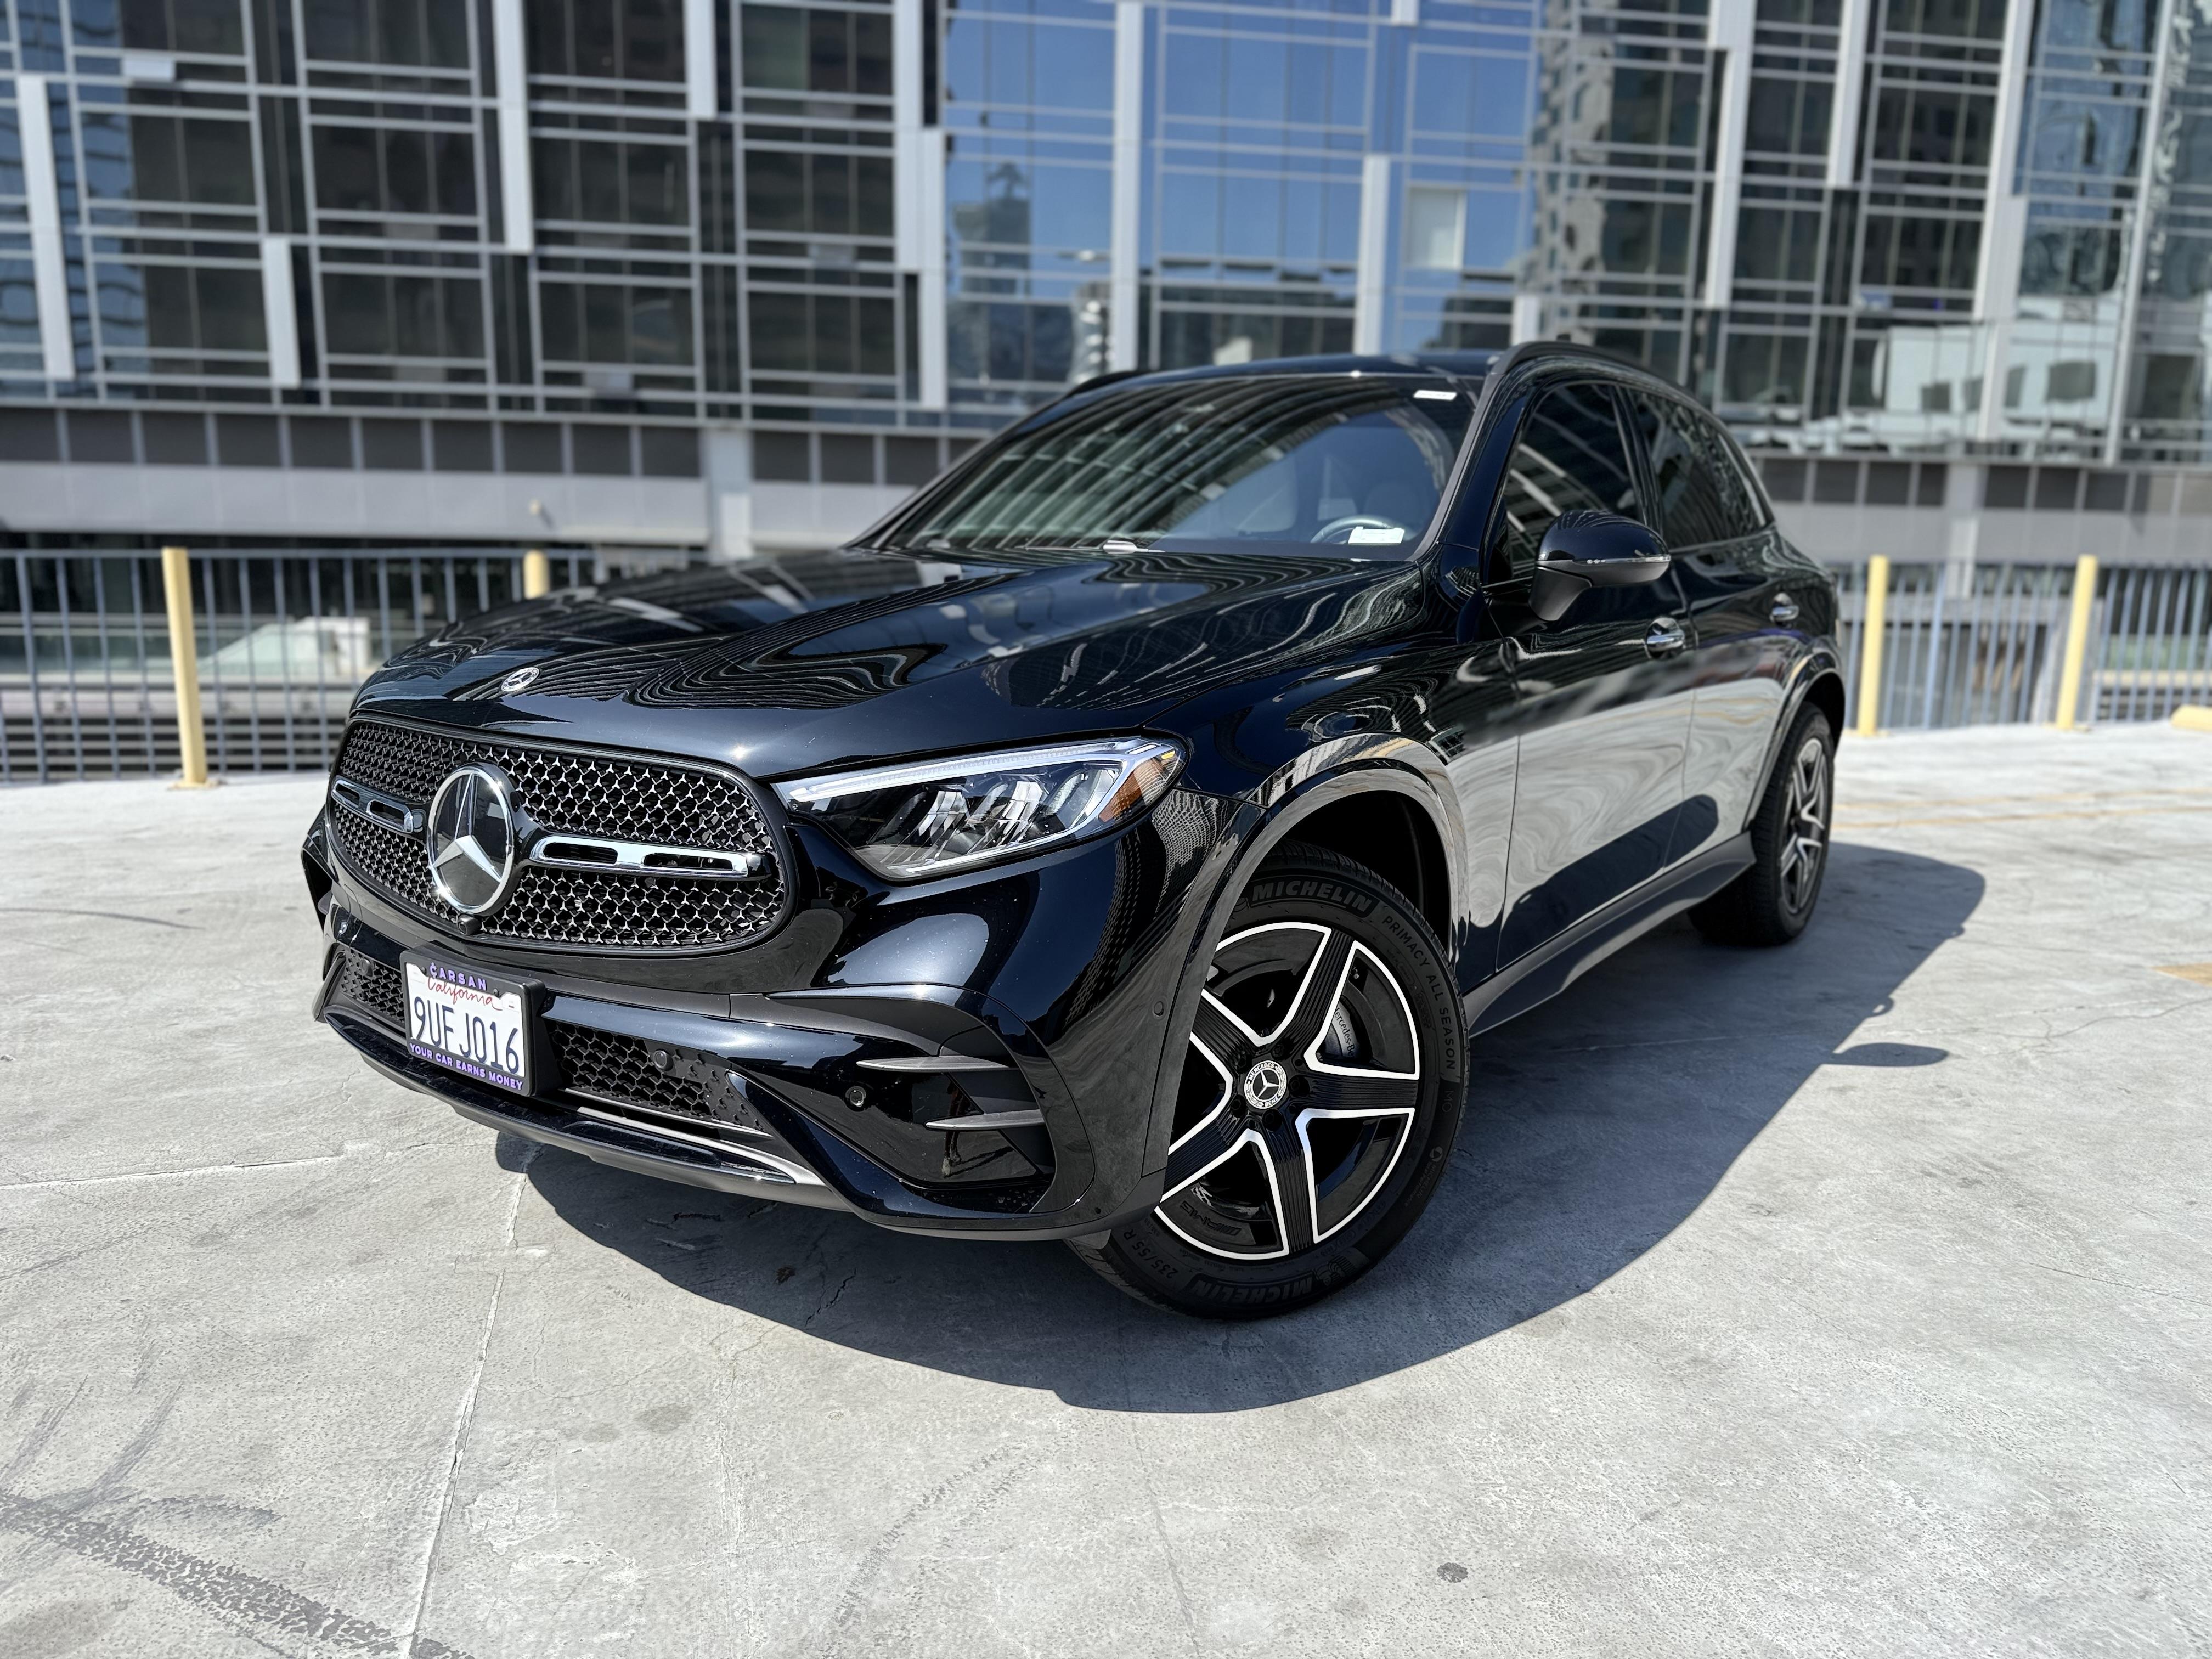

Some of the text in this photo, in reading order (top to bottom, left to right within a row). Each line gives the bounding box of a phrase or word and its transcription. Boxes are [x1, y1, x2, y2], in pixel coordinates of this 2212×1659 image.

[1252, 880, 1373, 913] MICHELIN
[427, 975, 503, 1011] California
[1382, 915, 1430, 967] PRIMACY
[1426, 974, 1444, 1001] ALL
[1439, 1006, 1456, 1070] SEASON
[414, 996, 519, 1075] 9UFJ016
[410, 1043, 523, 1091] YOUR CAR EARNS MONEY
[1249, 1062, 1275, 1081] MERCEDES
[1264, 1096, 1280, 1108] BENZ
[1132, 1242, 1178, 1279] 235/55
[1191, 1275, 1314, 1305] MICHELIN
